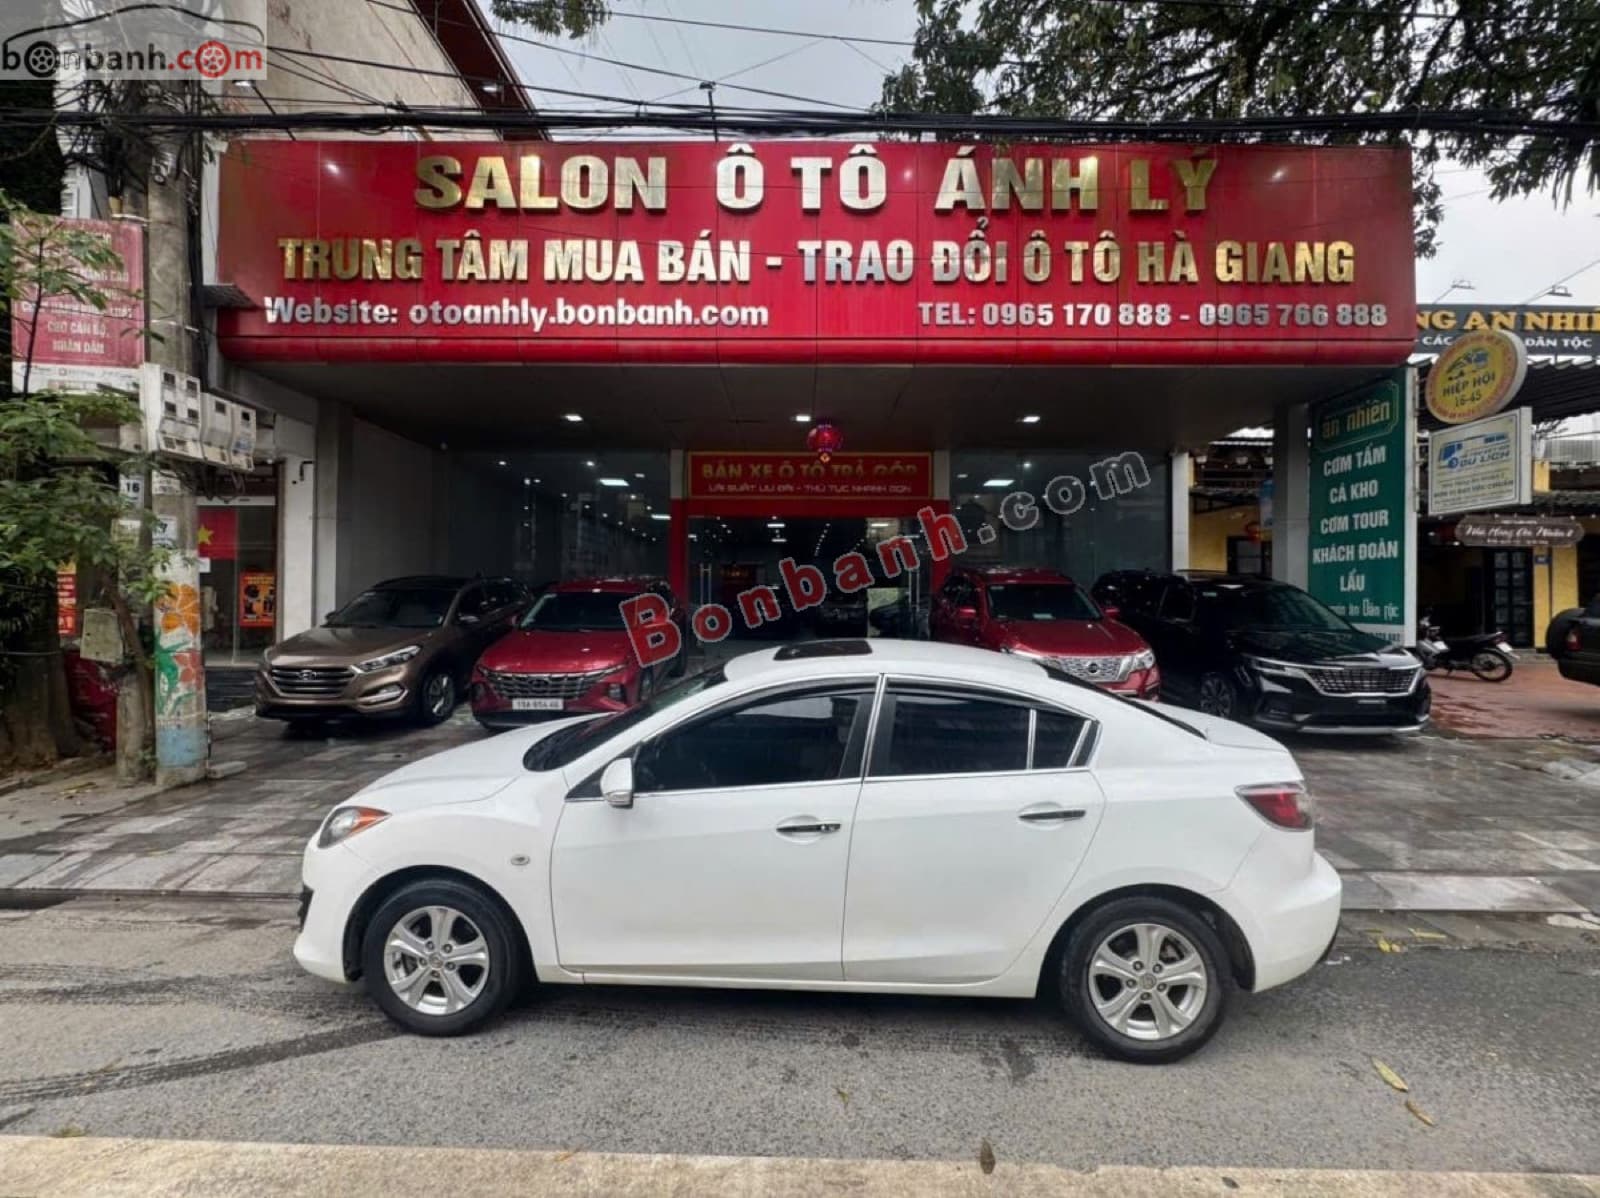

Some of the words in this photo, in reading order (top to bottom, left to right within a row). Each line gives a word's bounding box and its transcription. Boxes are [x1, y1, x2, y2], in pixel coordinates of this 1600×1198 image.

[415, 155, 667, 210] SALON
[716, 143, 764, 210] Ô
[791, 143, 887, 210] TÔ
[934, 145, 1098, 211] ÁNH
[1129, 149, 1219, 211] LÝ
[277, 239, 423, 282] TRUNG
[436, 229, 529, 282] TÂM
[544, 239, 644, 282] MUA
[657, 230, 751, 282] BÁN
[766, 257, 783, 269] -
[797, 239, 914, 283] TRAO
[931, 216, 1008, 283] ĐỔI
[1023, 230, 1051, 283] Ô
[1065, 230, 1121, 283] TÔ
[1137, 230, 1199, 283] HÀ
[1215, 240, 1355, 283] GIANG
[264, 296, 399, 326] Website:
[408, 298, 769, 333] otoanhly.bonbanh.com
[918, 302, 977, 326] TEL:
[982, 303, 1055, 327] 0965
[1063, 303, 1111, 327] 170
[1118, 303, 1172, 327] 888
[1199, 303, 1269, 327] 0965
[1277, 303, 1329, 327] 766
[1335, 303, 1389, 327] 888
[1463, 310, 1517, 331] AN
[1422, 333, 1454, 346] CÁC
[1525, 336, 1557, 347] DÂN
[1563, 336, 1593, 350] TỘC
[702, 460, 742, 478] BÁN
[750, 463, 771, 478] XE
[779, 461, 795, 478] Ô
[800, 460, 825, 478] TÔ
[1322, 454, 1353, 478] CƠM
[1355, 442, 1387, 468] TẤM
[1350, 479, 1379, 501] KHO
[1320, 513, 1349, 535] CƠM
[1352, 509, 1389, 531] TOUR
[1312, 542, 1355, 565] KHÁCH
[1358, 536, 1399, 560] ĐOÀN
